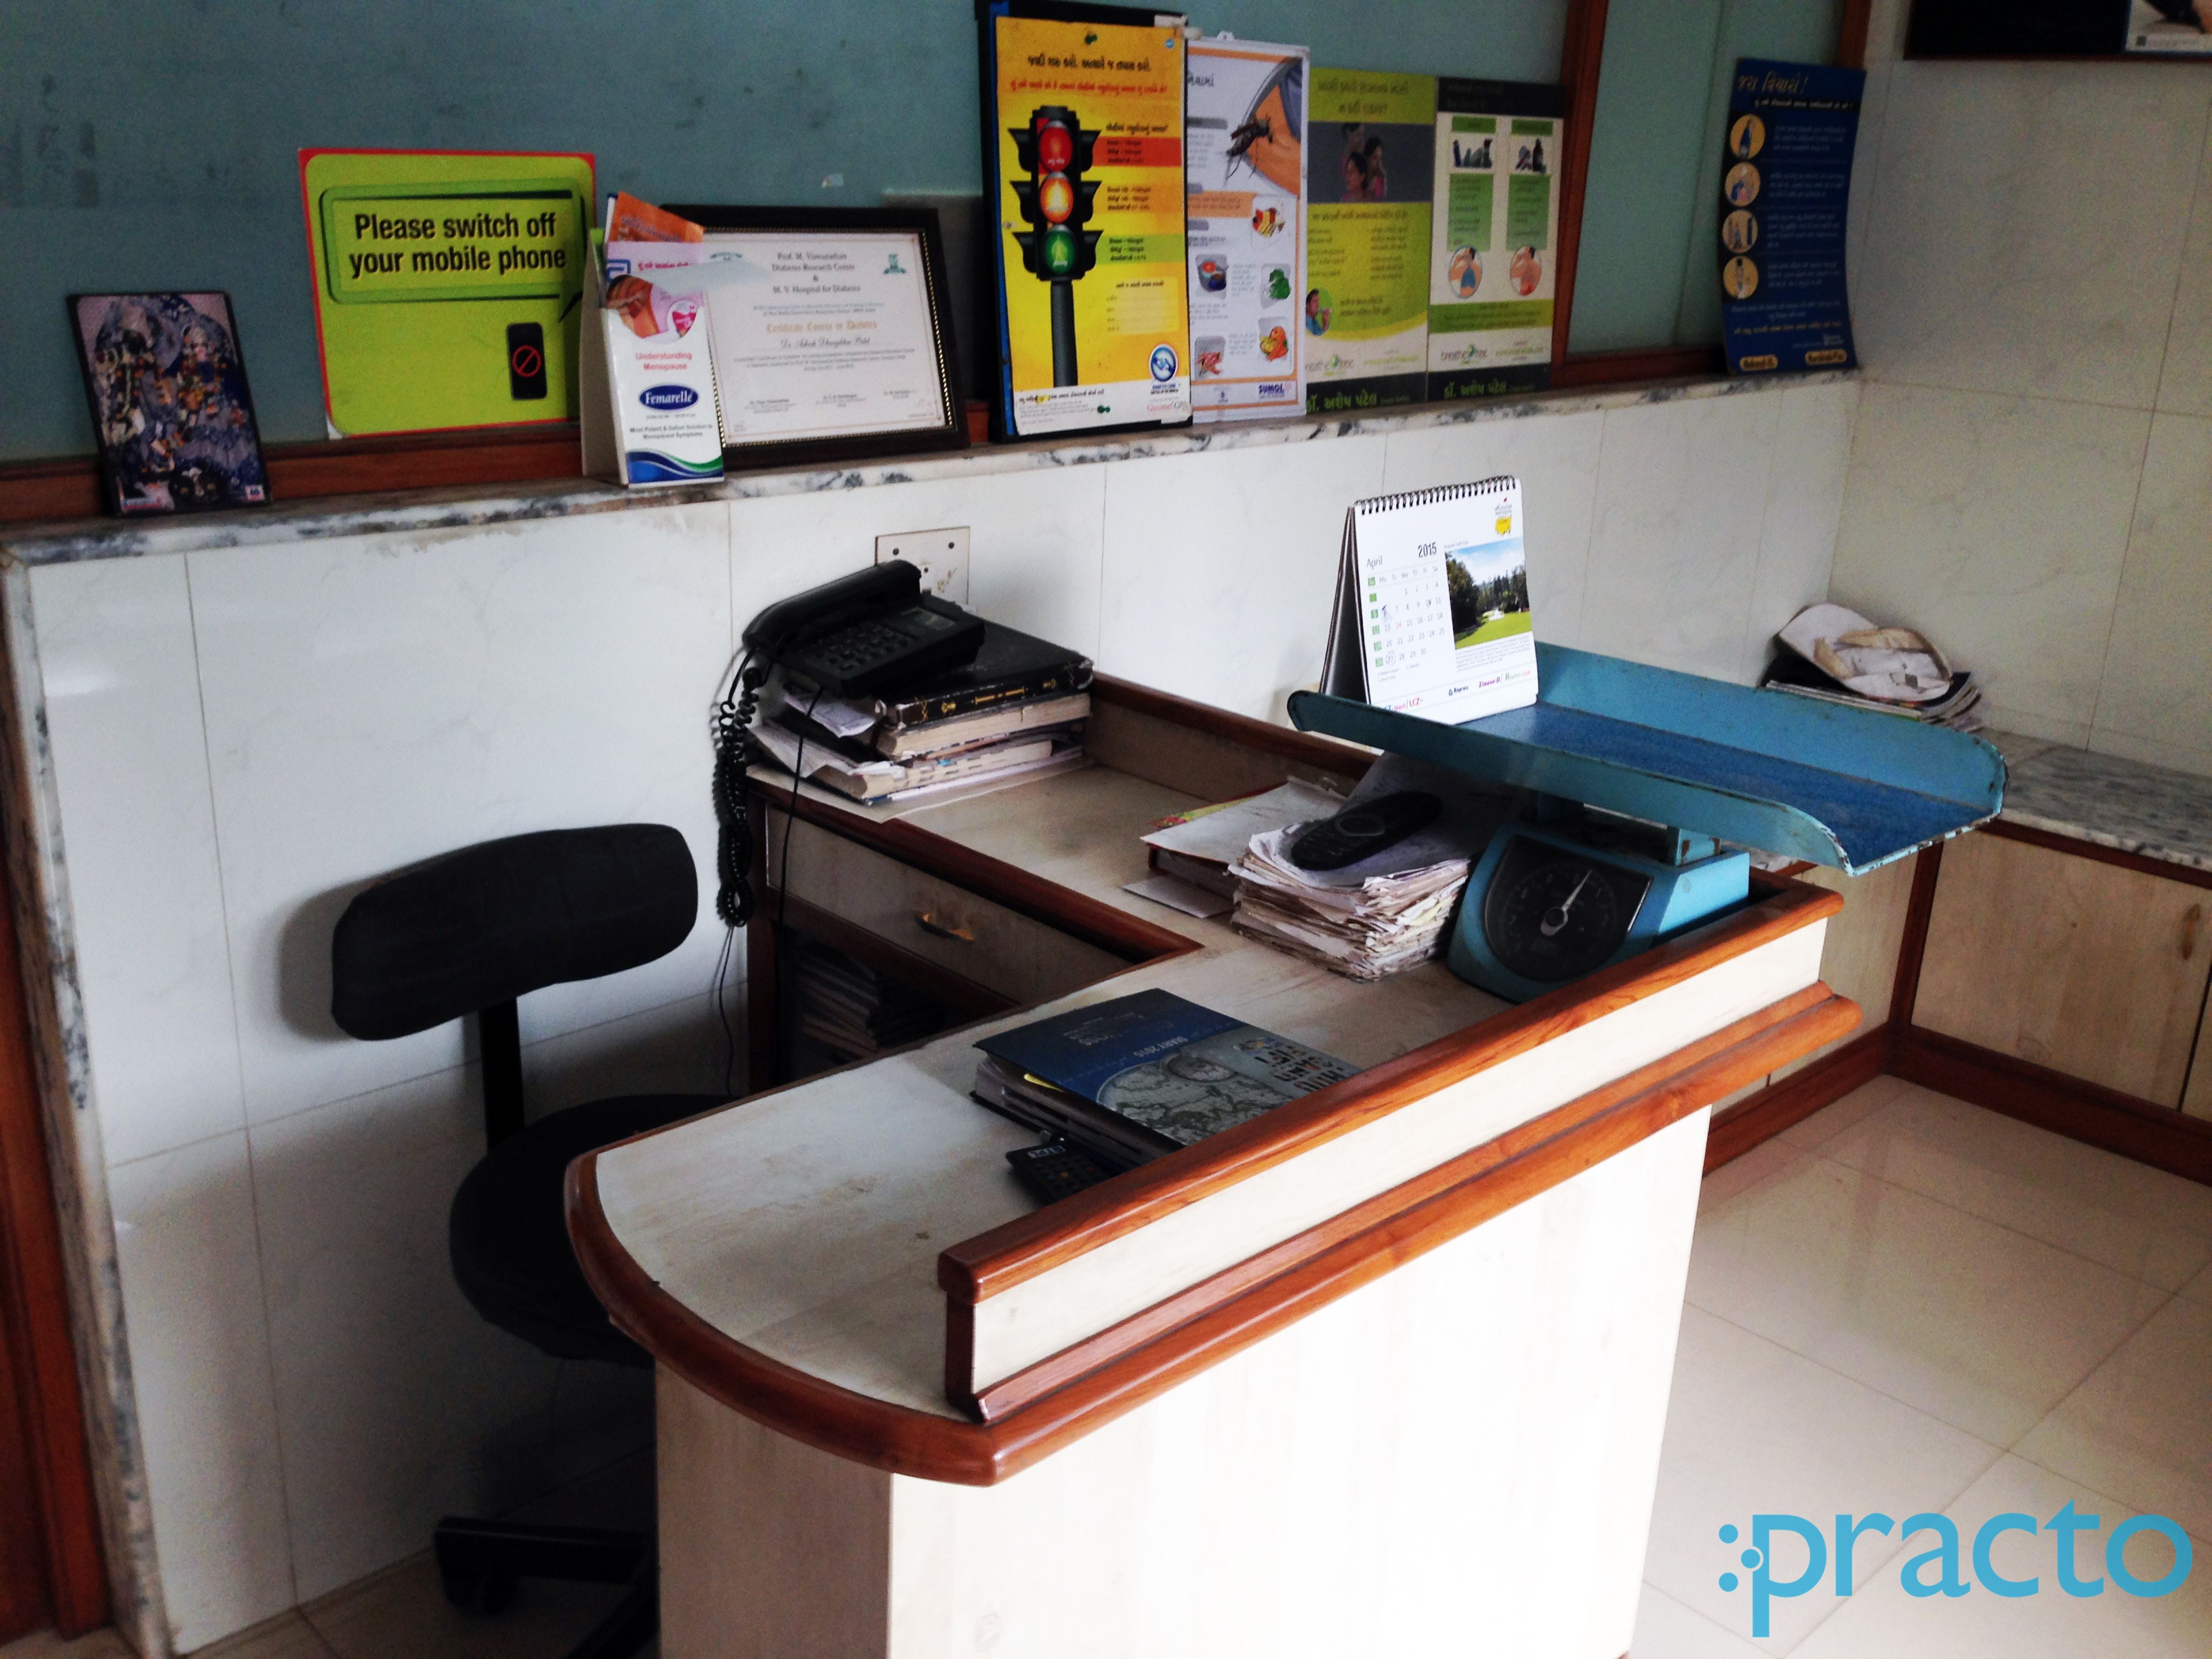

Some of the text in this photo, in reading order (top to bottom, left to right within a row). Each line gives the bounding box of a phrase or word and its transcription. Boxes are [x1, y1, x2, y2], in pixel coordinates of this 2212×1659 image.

[354, 212, 556, 239] Please switch off
[350, 246, 566, 279] your mobile phone
[635, 352, 693, 361] Understanding
[643, 363, 687, 371] Menopause
[646, 391, 693, 404] Femarelle
[1418, 542, 1437, 558] 2015
[1367, 555, 1382, 570] April
